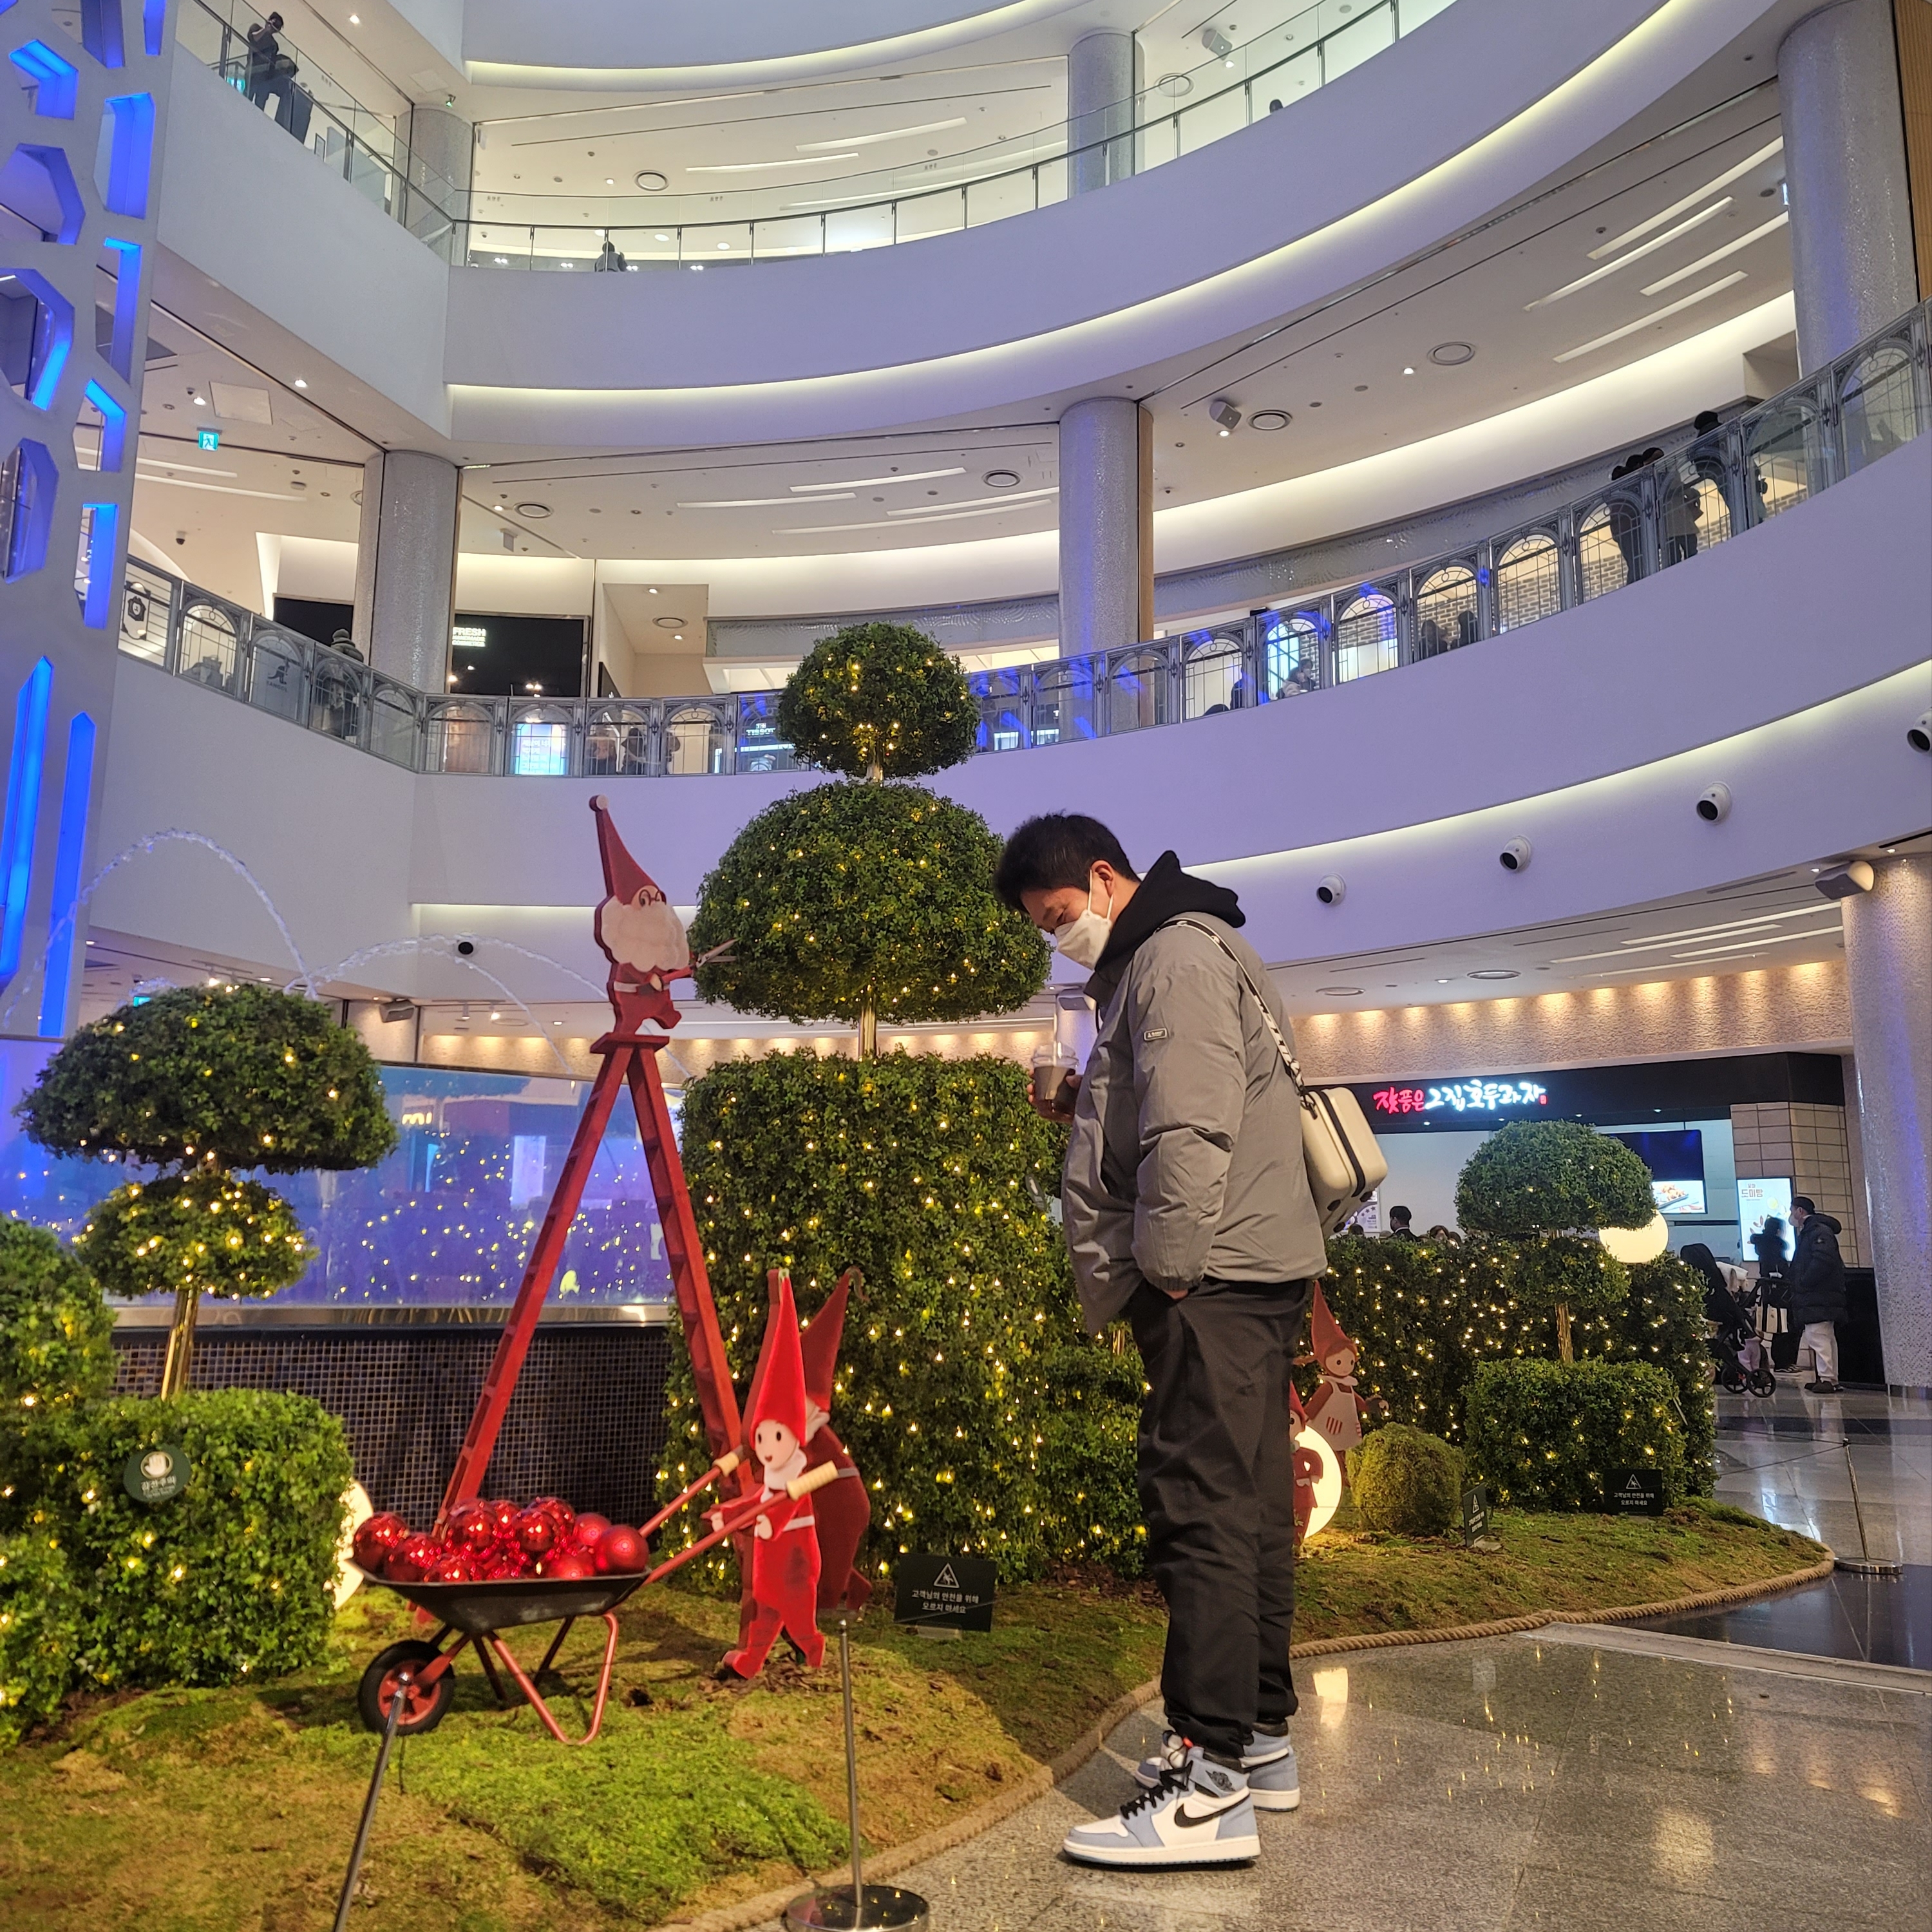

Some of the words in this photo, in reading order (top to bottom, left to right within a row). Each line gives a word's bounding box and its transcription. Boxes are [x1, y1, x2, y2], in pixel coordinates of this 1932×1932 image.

[453, 627, 486, 636] FRESH
[911, 1589, 940, 1600] 고객님의
[942, 1591, 963, 1603] 안전을
[965, 1593, 979, 1604] 위해
[922, 1600, 943, 1611] 오르지
[945, 1603, 966, 1614] 마세요
